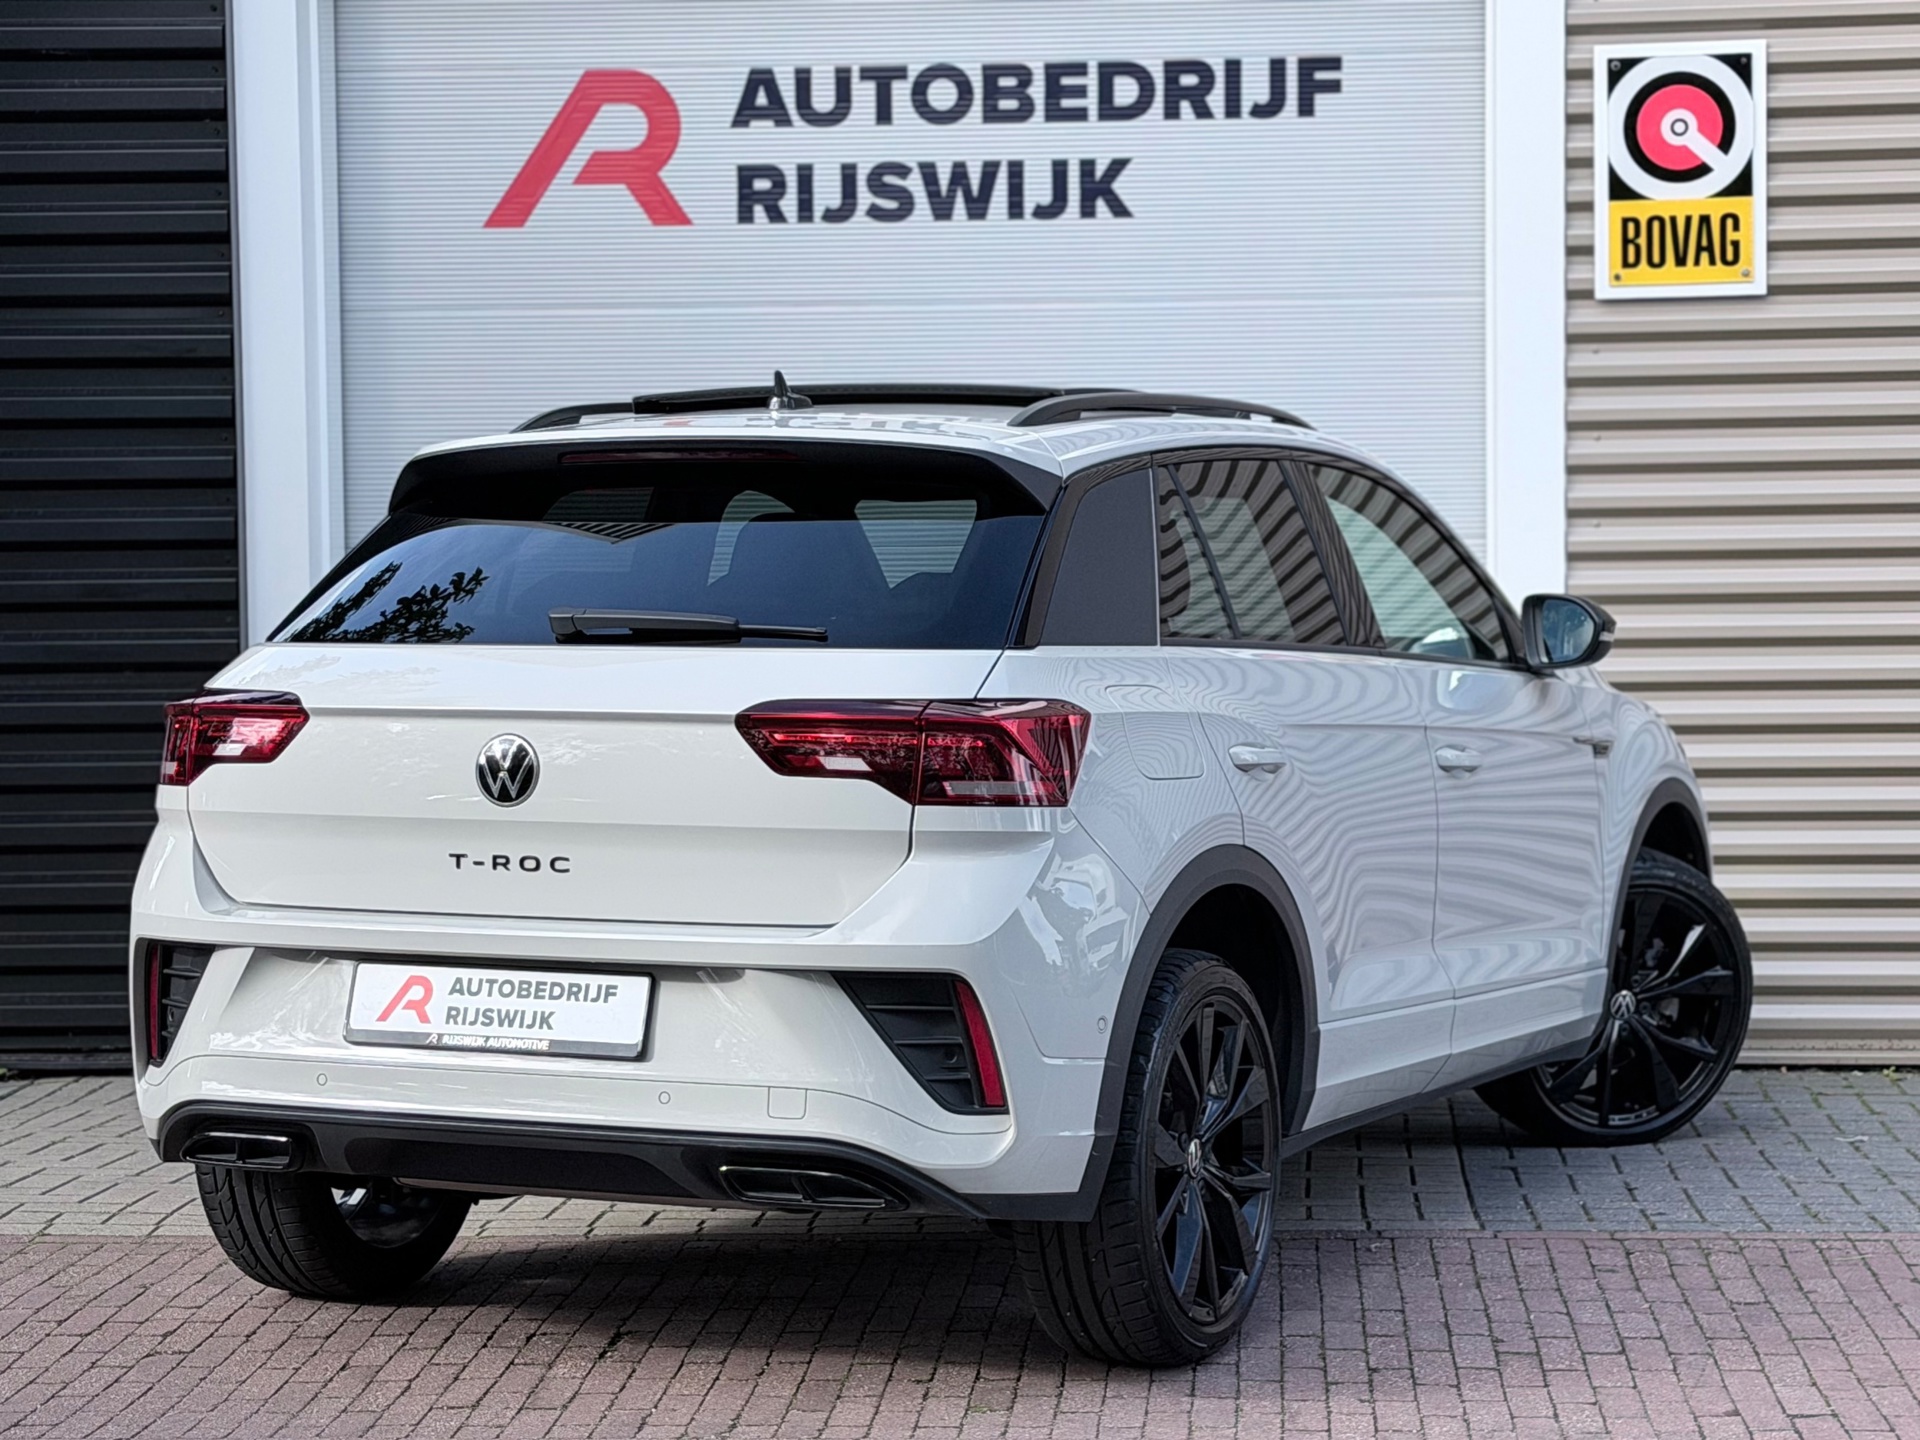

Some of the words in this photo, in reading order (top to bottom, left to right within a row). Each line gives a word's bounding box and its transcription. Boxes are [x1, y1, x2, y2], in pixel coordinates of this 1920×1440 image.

[730, 56, 1343, 129] AUTOBEDRIJF
[736, 158, 1135, 225] RIJSWIJK
[1621, 212, 1741, 269] BOVAG
[448, 852, 571, 874] T-ROC
[447, 976, 619, 1004] AUTOBEDRIJF
[444, 1006, 556, 1031] RIJSWIJK
[442, 1034, 486, 1047] RIJSWIJK
[486, 1036, 551, 1050] AUTOMOTIVE
